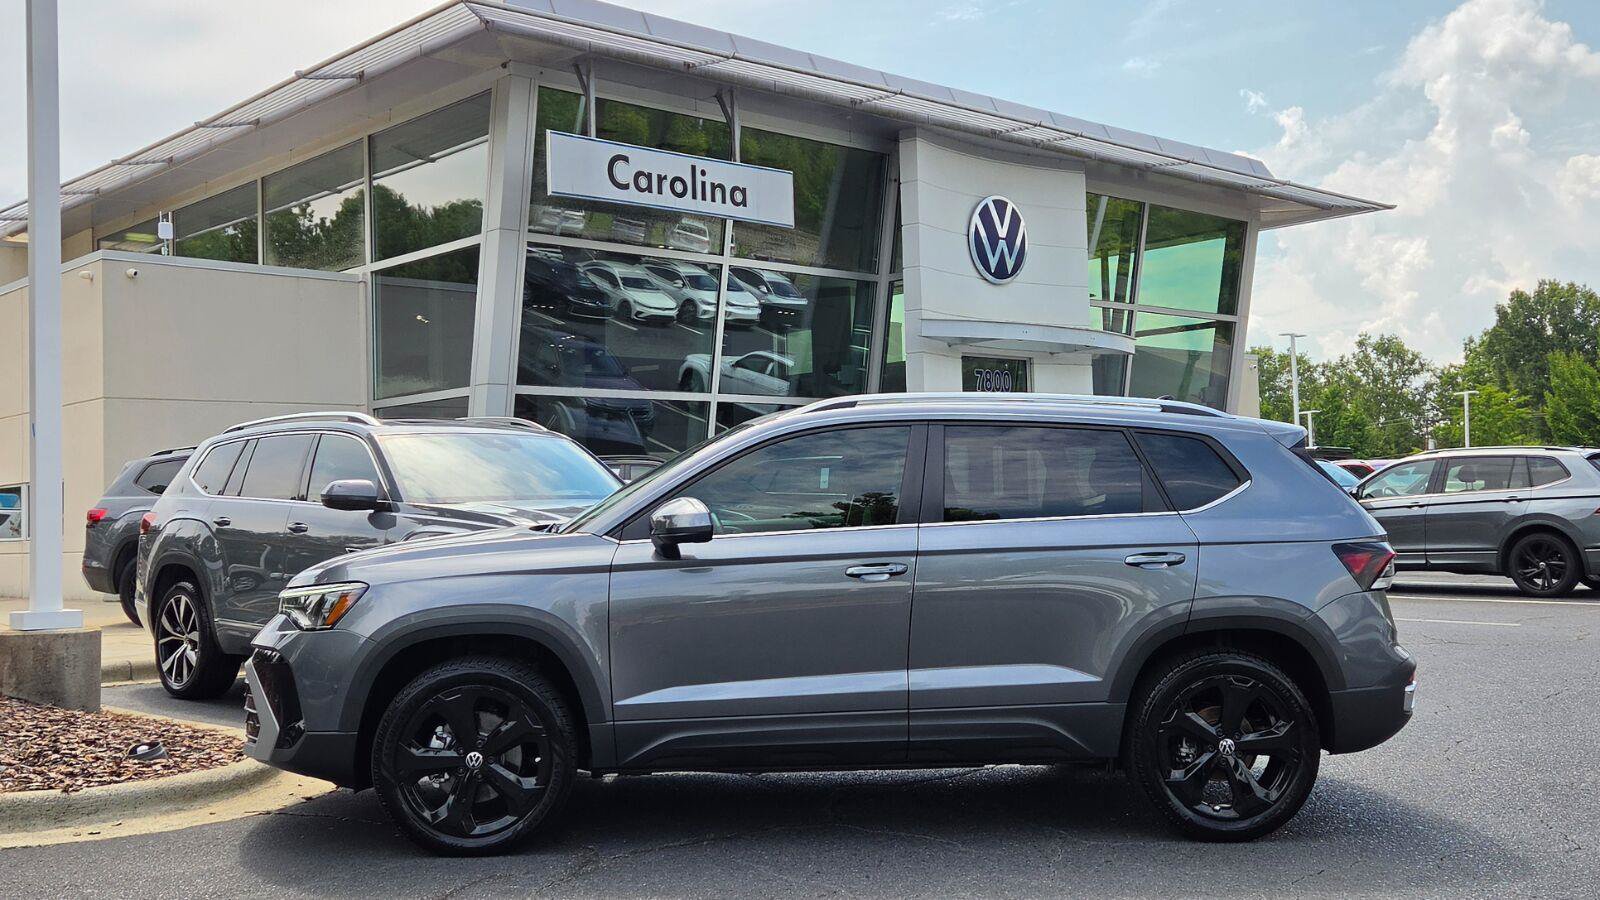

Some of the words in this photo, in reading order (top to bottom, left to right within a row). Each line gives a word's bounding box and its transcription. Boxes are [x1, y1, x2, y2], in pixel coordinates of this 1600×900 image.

[607, 154, 748, 208] Carolina
[971, 197, 1027, 279] VW
[974, 369, 1012, 392] 7800
[466, 752, 482, 768] VW
